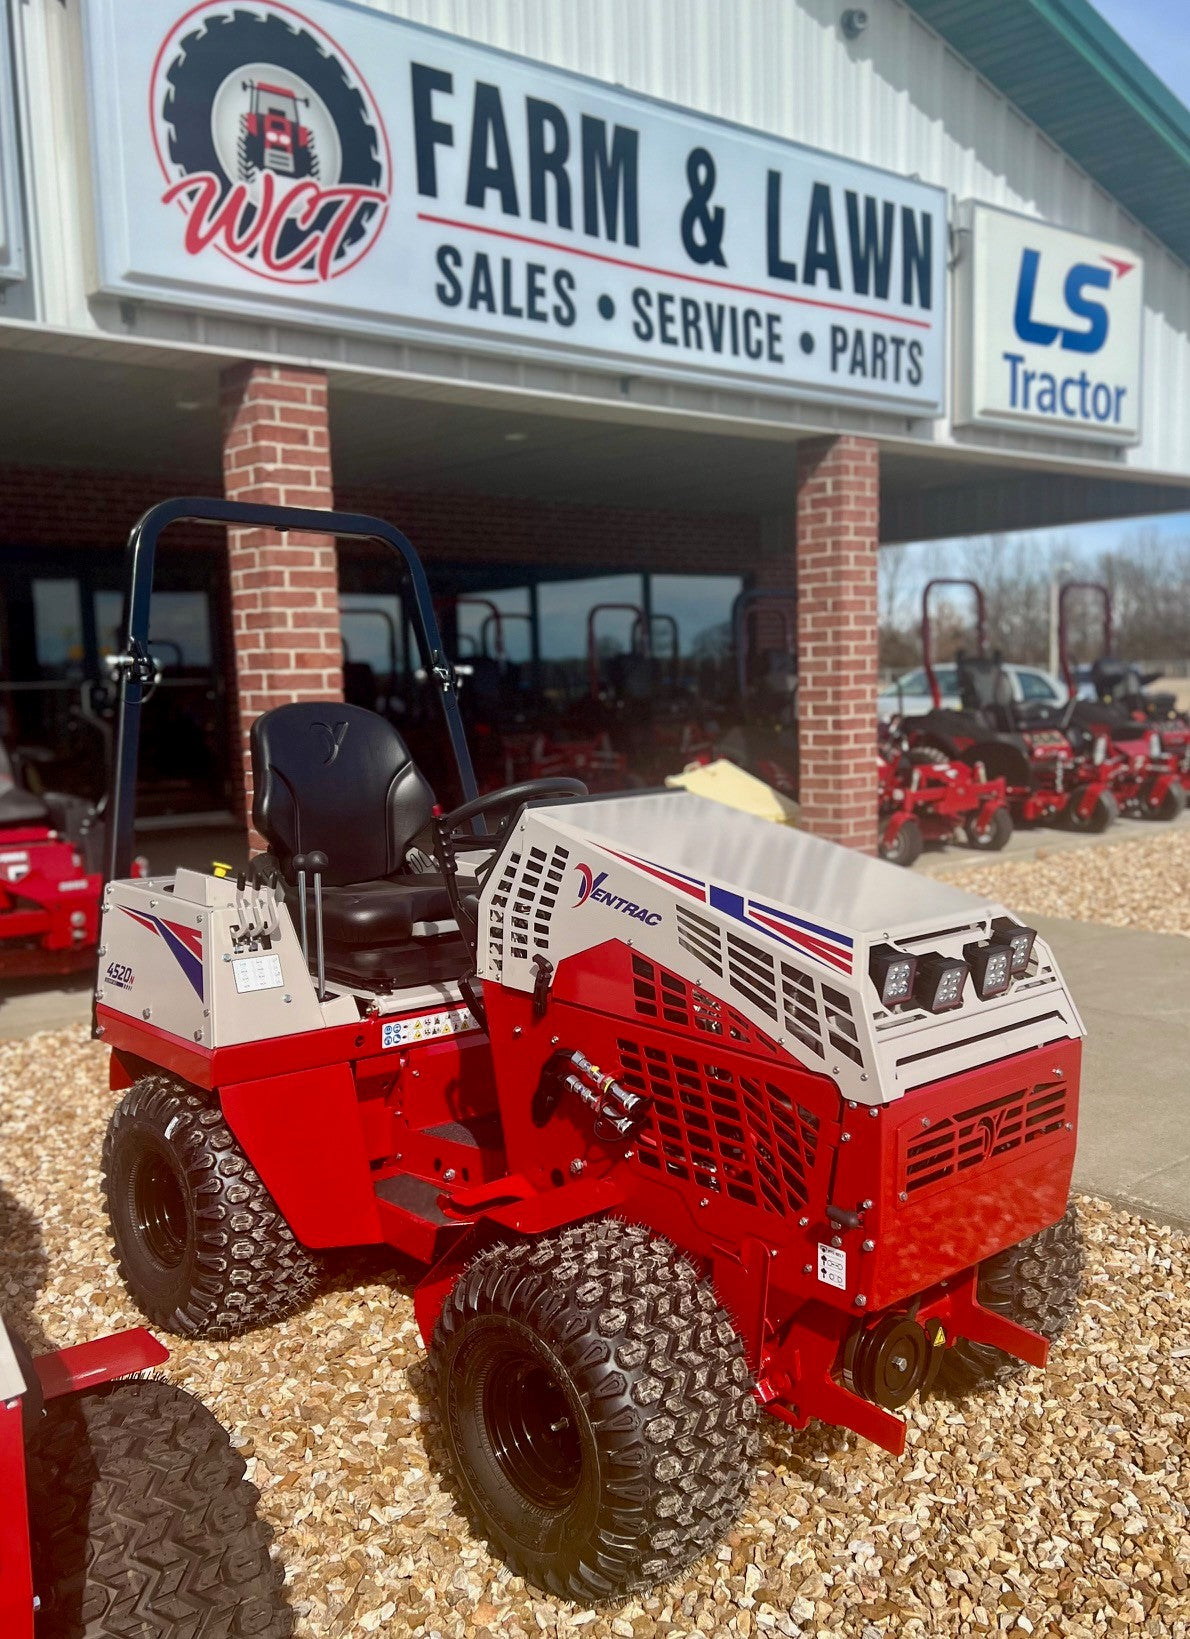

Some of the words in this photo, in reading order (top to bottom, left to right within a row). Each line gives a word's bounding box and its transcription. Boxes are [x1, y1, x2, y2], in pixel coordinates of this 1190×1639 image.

[162, 171, 388, 282] WCT
[411, 61, 640, 249] FARM
[681, 146, 727, 268] &
[766, 169, 932, 310] LAWN
[436, 244, 576, 327] SALES
[632, 286, 784, 364] SERVICE
[830, 324, 923, 387] PARTS
[1013, 247, 1113, 354] LS
[1003, 352, 1127, 424] Tractor
[571, 863, 662, 926] VENTRAC
